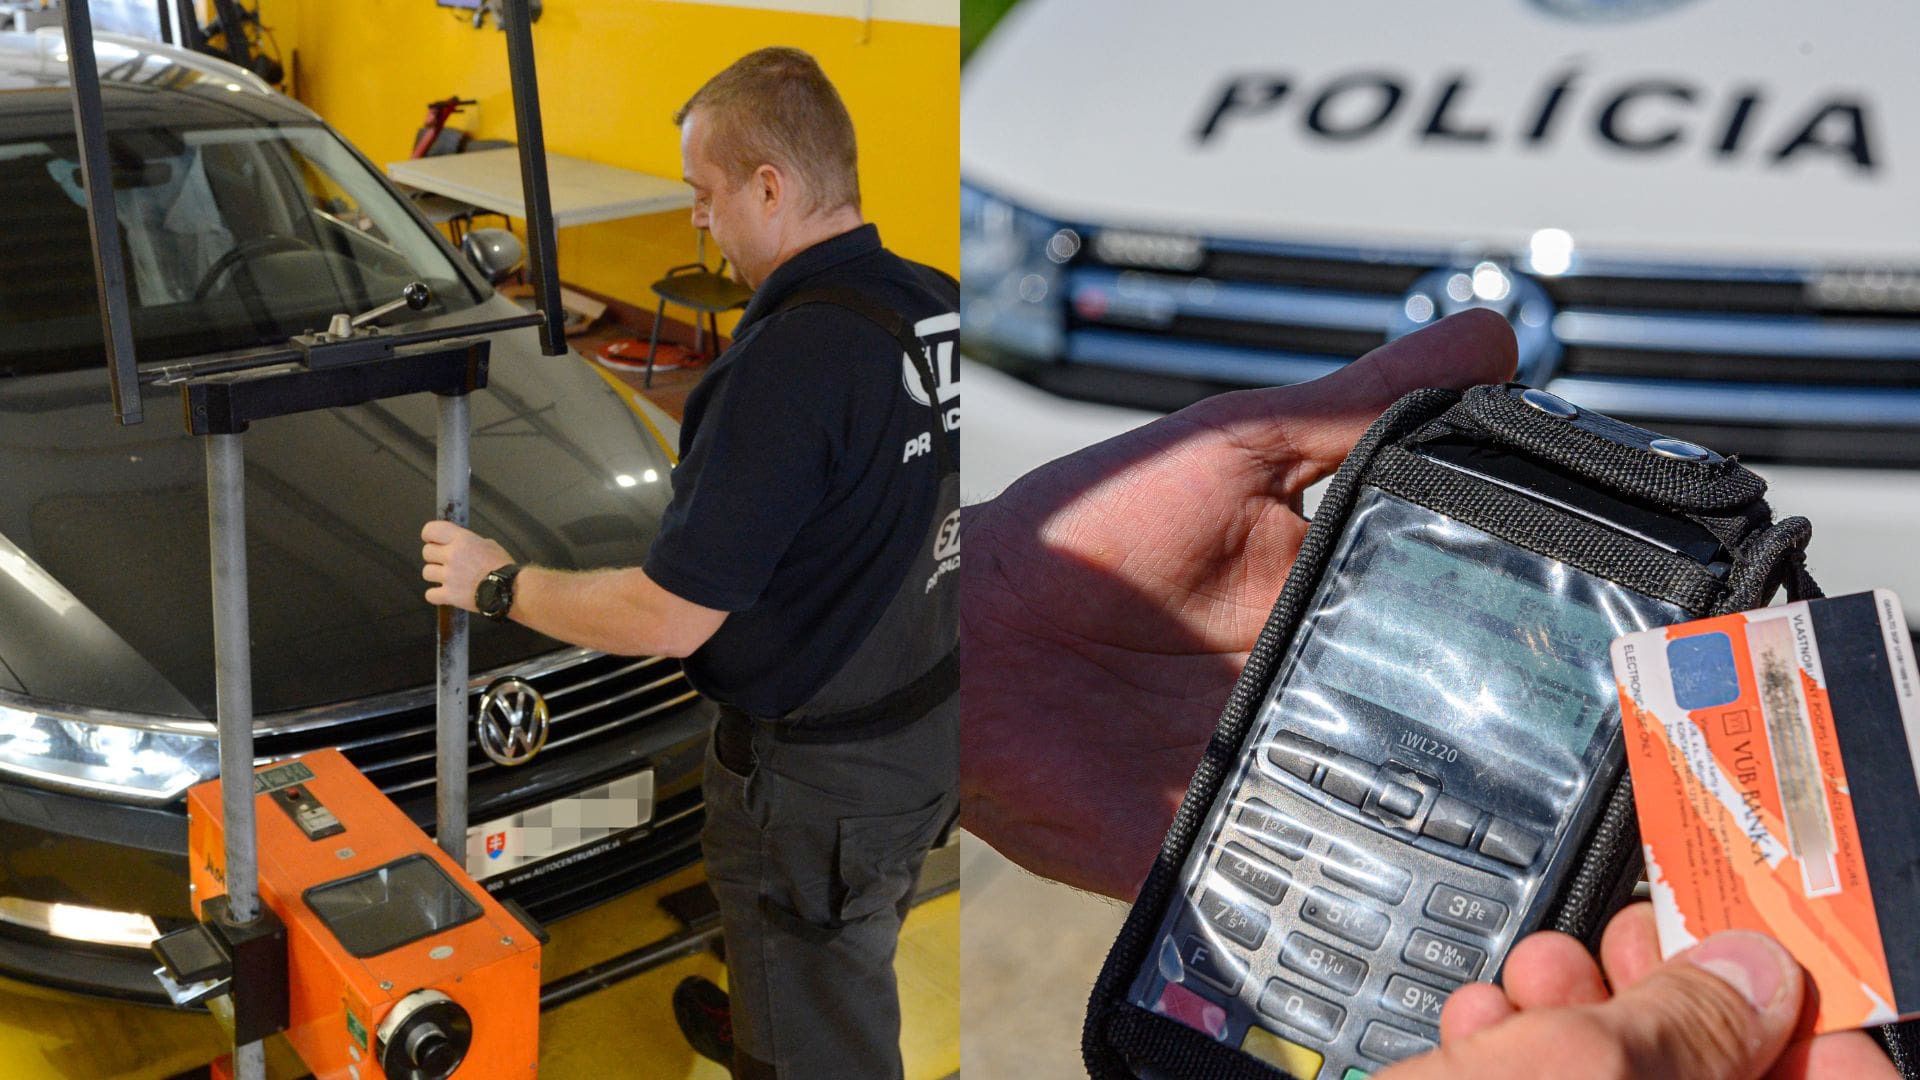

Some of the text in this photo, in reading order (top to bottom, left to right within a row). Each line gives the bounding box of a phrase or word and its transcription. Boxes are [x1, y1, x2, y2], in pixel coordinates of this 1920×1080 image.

[1194, 53, 1879, 172] POLÍCIA
[1624, 644, 1653, 759] ELECTRONIC USE ONLY
[1401, 729, 1458, 763] iWL220
[1732, 739, 1771, 866] VÚB BANKA
[1233, 859, 1249, 876] 4
[1213, 901, 1230, 921] 7
[1327, 903, 1343, 922] 5
[1449, 895, 1467, 917] 3
[1191, 947, 1207, 965] F
[1307, 948, 1324, 968] 8
[1424, 939, 1441, 960] 6
[1285, 995, 1302, 1015] 0
[1402, 986, 1420, 1007] 9
